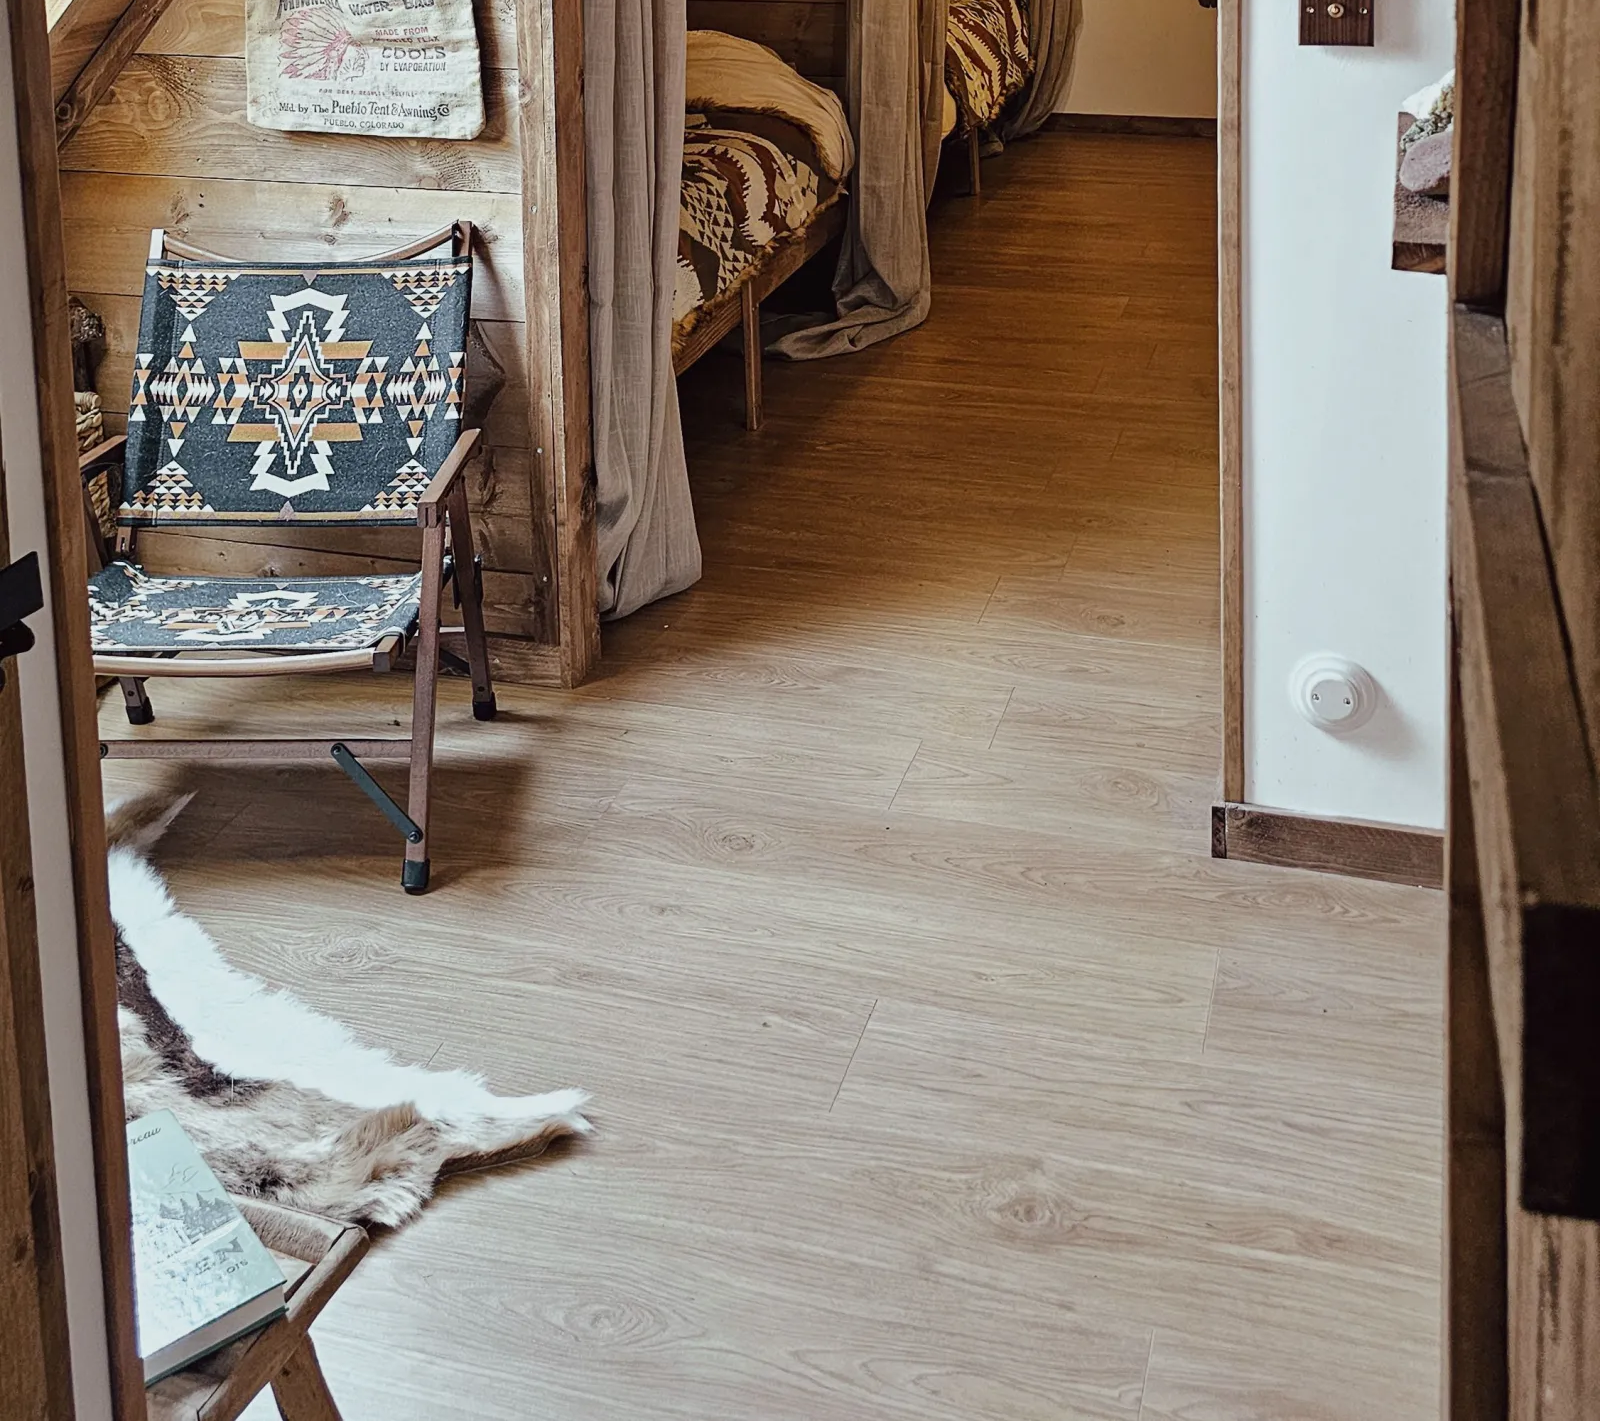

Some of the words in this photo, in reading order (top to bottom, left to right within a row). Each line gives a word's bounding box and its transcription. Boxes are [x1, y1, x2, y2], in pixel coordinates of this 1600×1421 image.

[348, 0, 393, 16] WATER
[403, 26, 429, 36] FROM
[381, 46, 446, 60] COOLS
[393, 62, 446, 72] EVAPORATION
[298, 101, 309, 114] by
[312, 104, 329, 114] The
[331, 100, 367, 116] Pueblo
[367, 101, 390, 116] Tent
[398, 103, 438, 122] Awning
[360, 120, 405, 129] COLORADO
